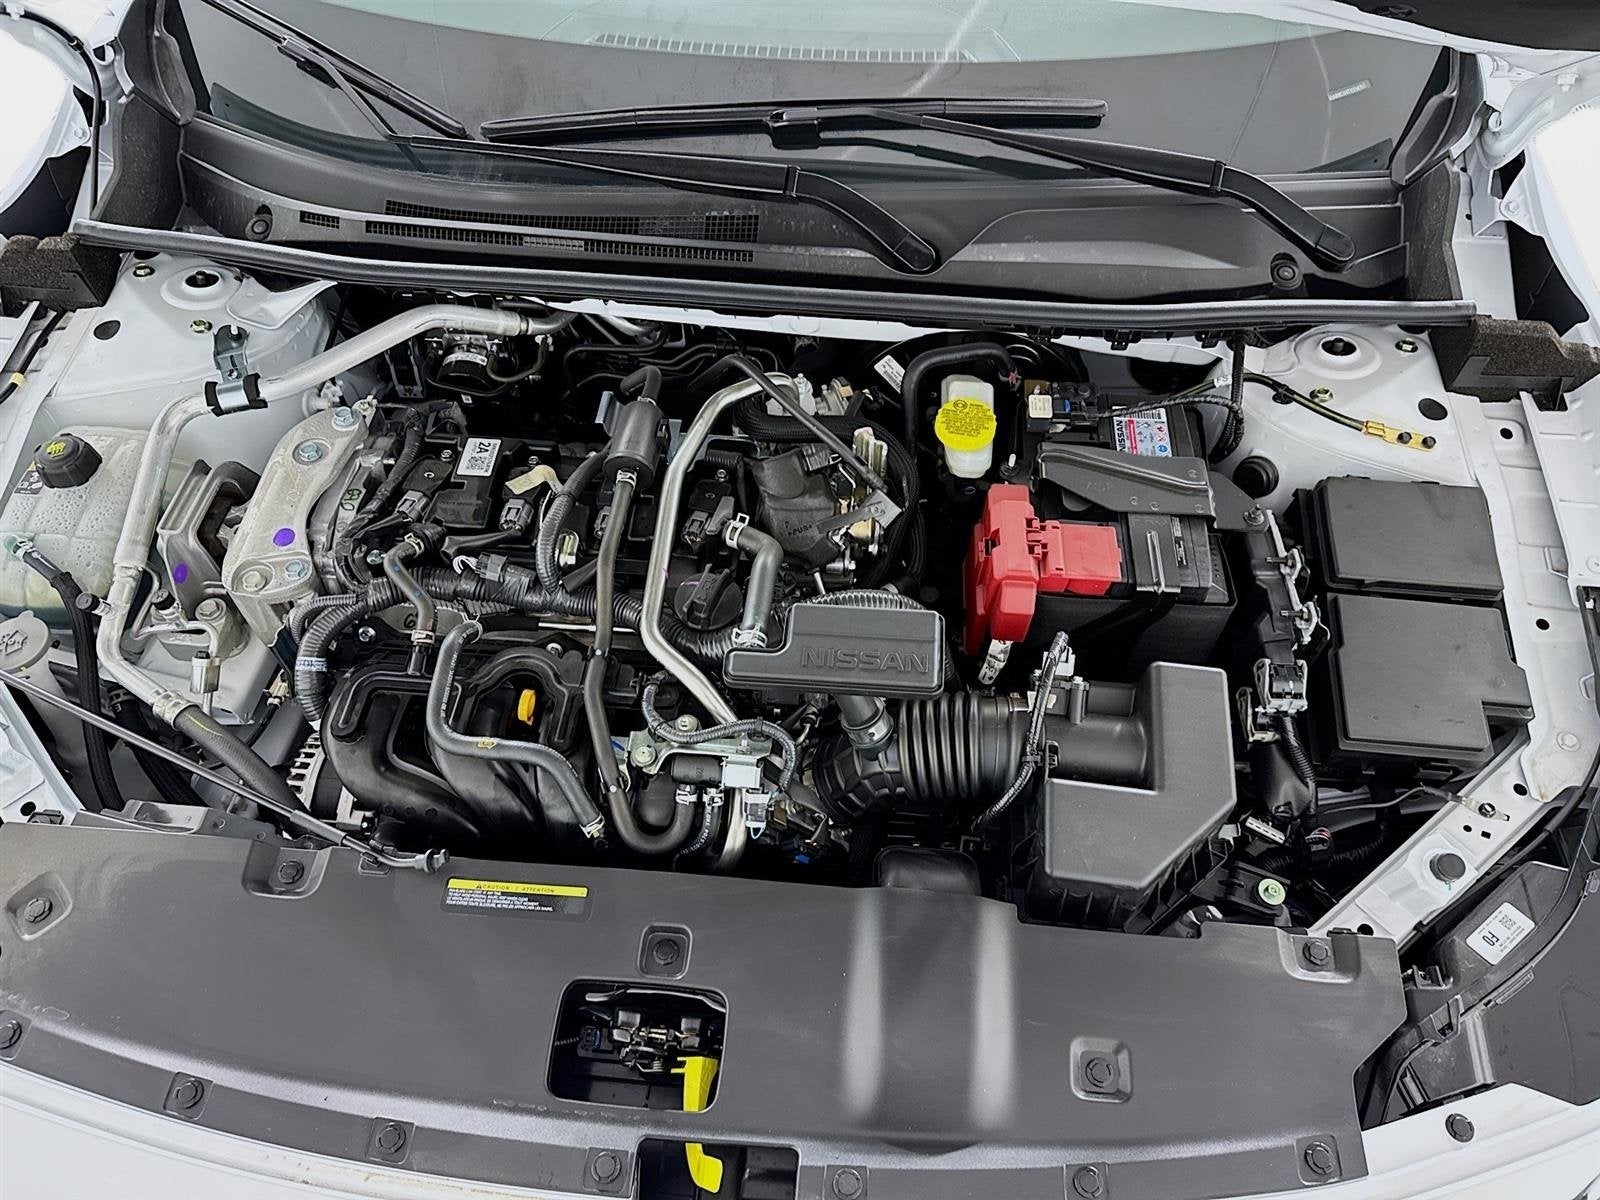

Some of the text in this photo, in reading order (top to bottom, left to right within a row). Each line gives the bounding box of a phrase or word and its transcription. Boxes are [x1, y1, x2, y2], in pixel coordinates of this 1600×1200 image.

[1118, 420, 1126, 453] NISSAN
[476, 441, 491, 454] 2A
[801, 647, 930, 674] NISSAN
[483, 883, 511, 891] CAUTION
